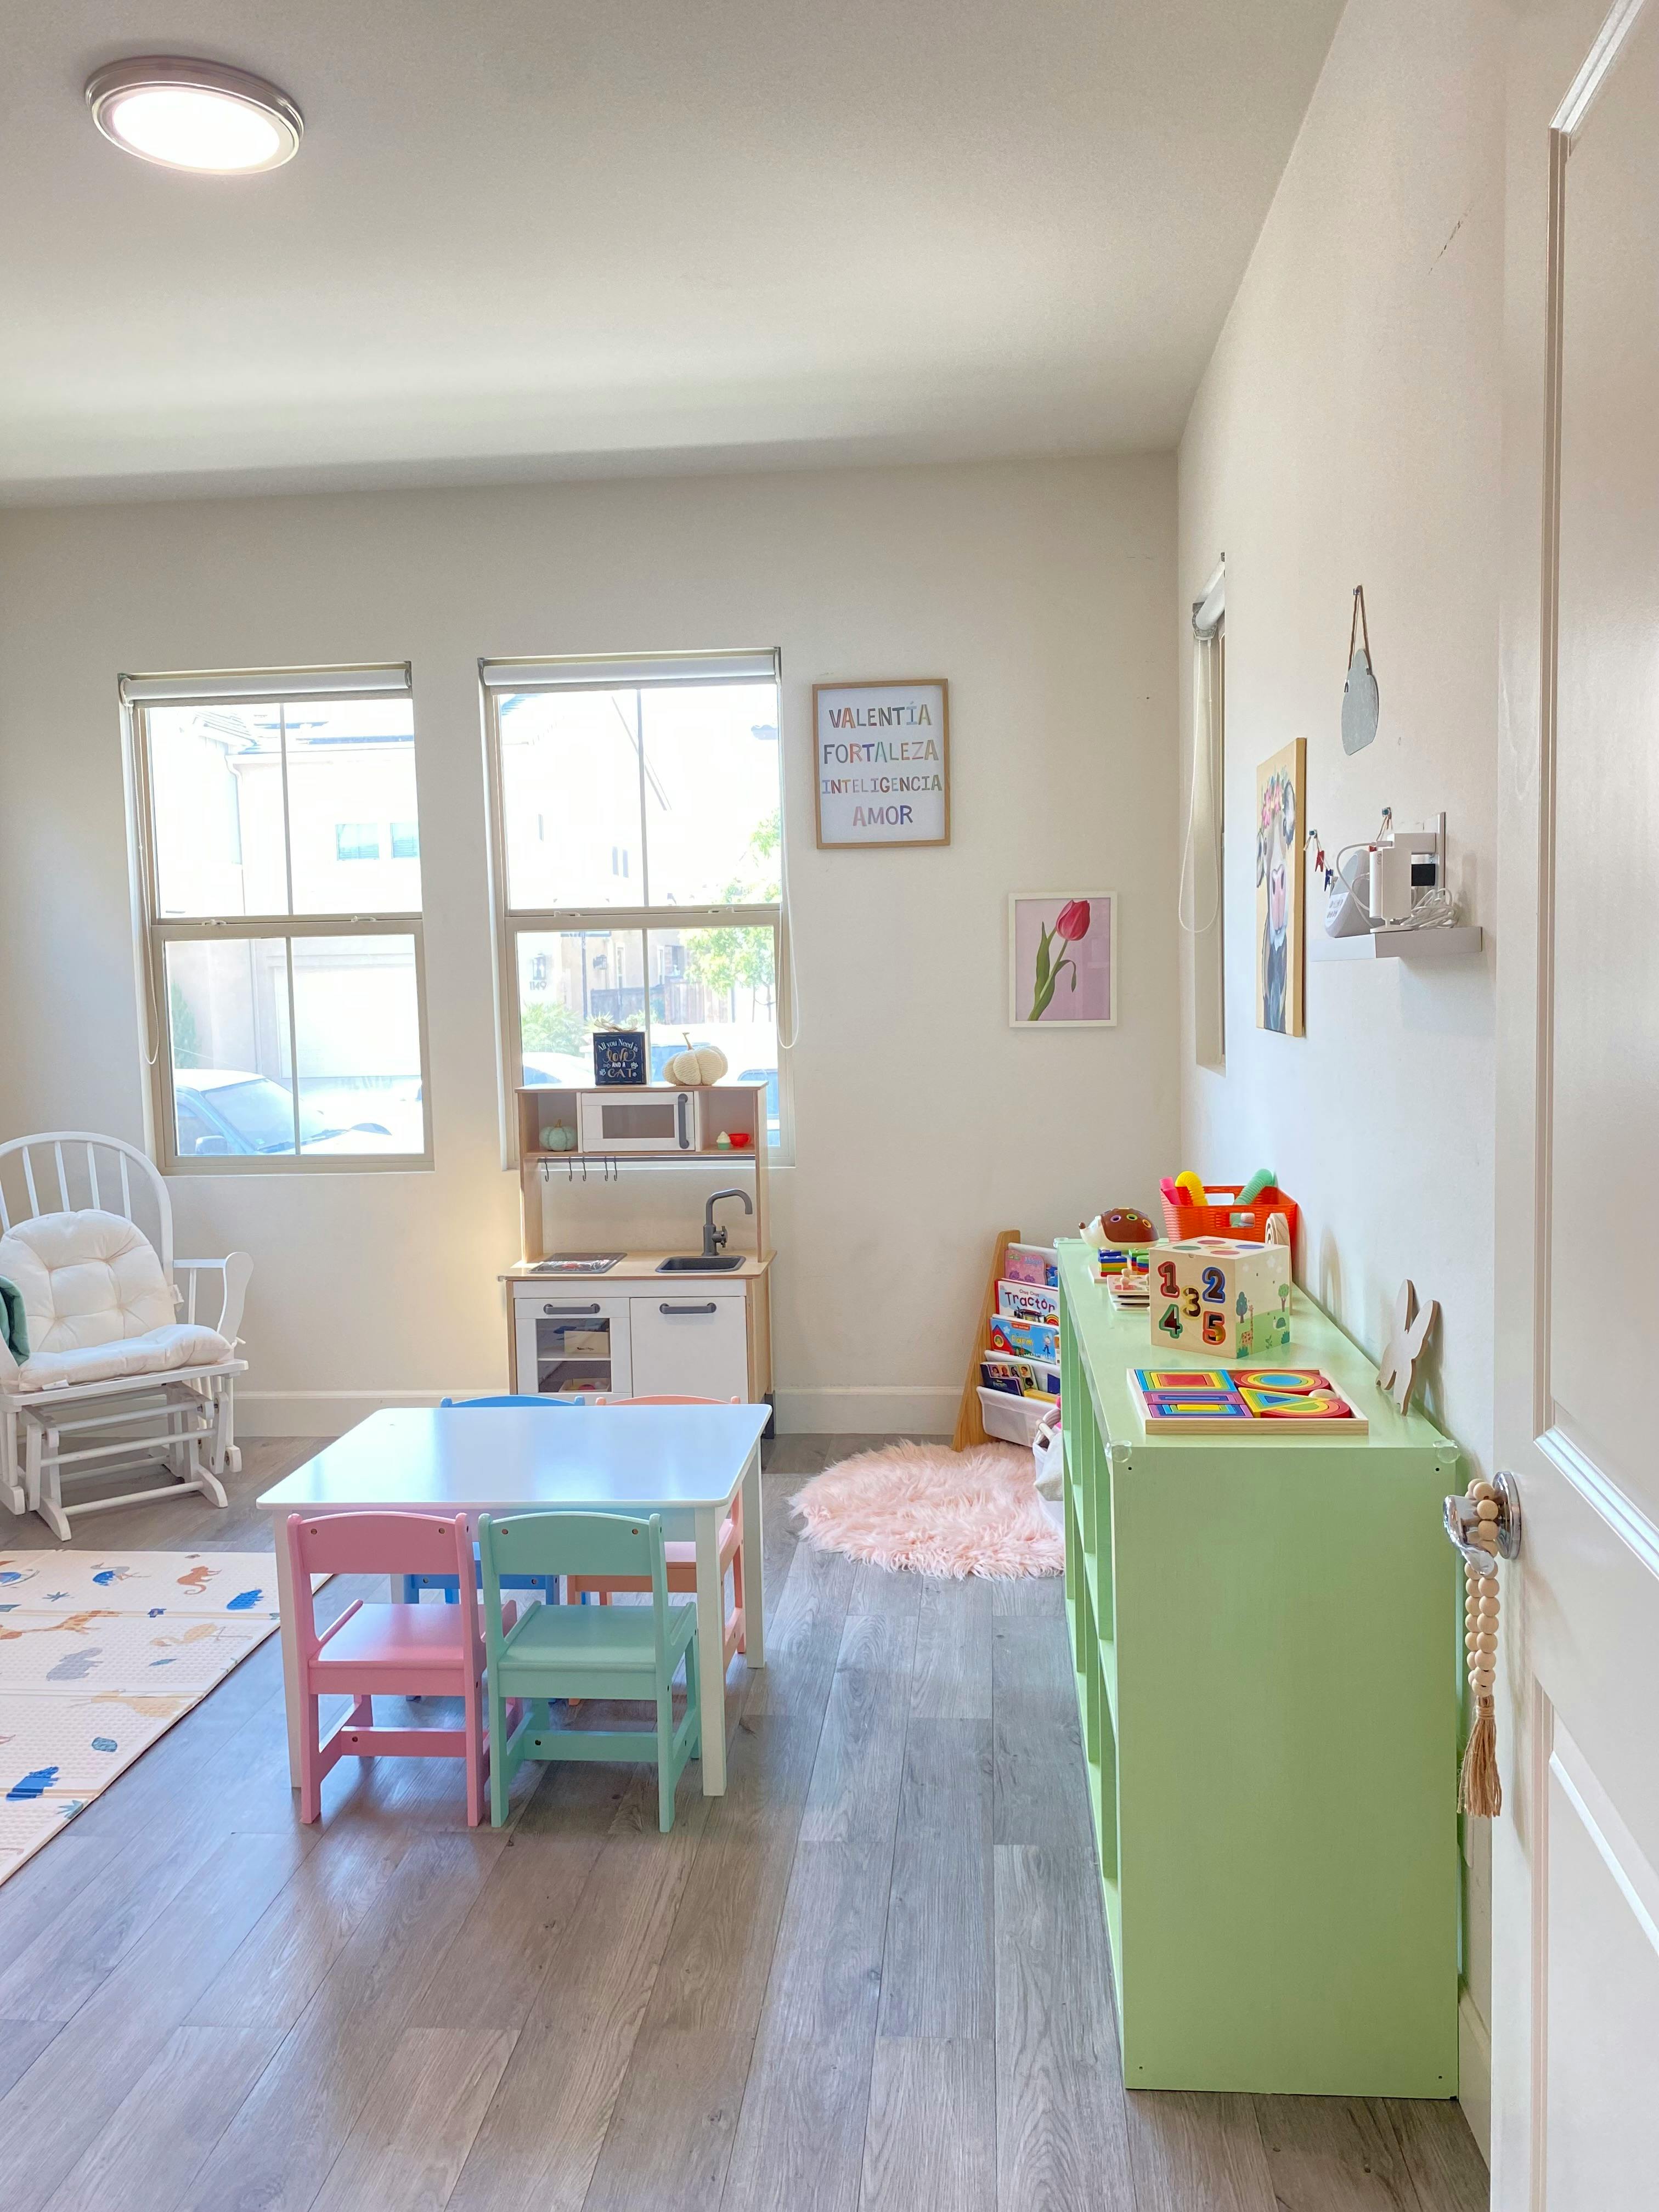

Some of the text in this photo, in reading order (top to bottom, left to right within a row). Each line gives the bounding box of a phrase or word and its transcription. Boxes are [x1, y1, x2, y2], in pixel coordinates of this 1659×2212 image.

[828, 701, 932, 729] VALENTÍA
[824, 740, 939, 764] FORTALEZA
[822, 775, 943, 794] INTELIGENCIA
[853, 805, 913, 827] AMOR
[529, 981, 547, 991] 1149
[598, 1042, 607, 1052] All
[618, 1038, 634, 1049] Need
[633, 1043, 639, 1052] is
[607, 1068, 634, 1078] CAT
[1158, 1261, 1226, 1304] 1 2
[1005, 1292, 1056, 1313] Tractor
[1181, 1285, 1202, 1320] 3
[1159, 1304, 1226, 1345] 4 5
